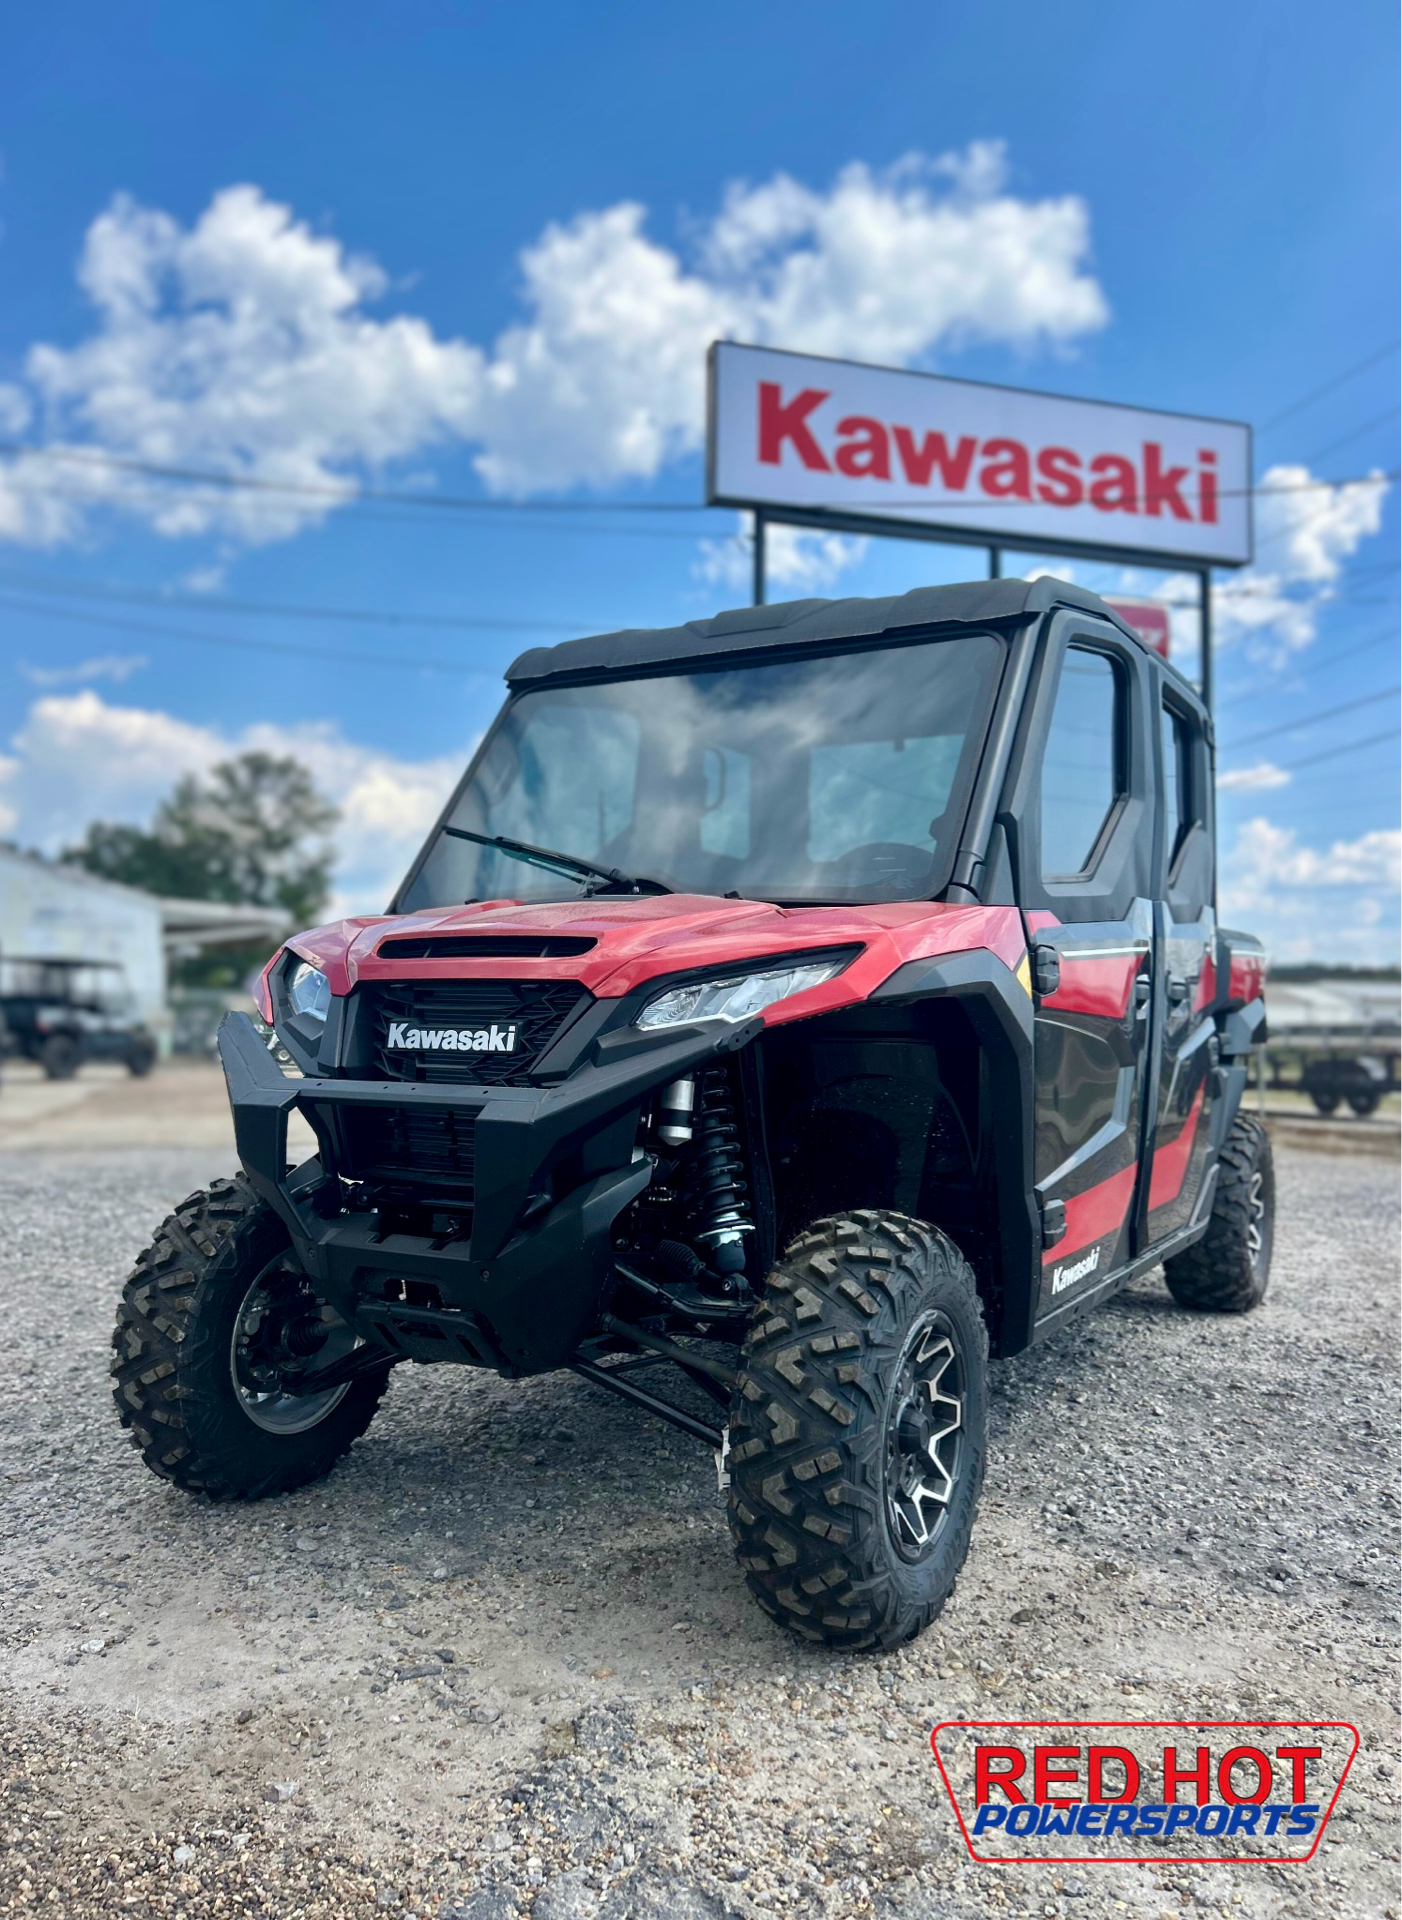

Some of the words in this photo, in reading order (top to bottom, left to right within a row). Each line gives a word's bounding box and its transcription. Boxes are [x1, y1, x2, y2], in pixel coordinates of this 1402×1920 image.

[758, 381, 1218, 524] Kawasaki
[387, 1023, 516, 1052] Kawasaki
[1051, 1246, 1100, 1295] Kawasaki
